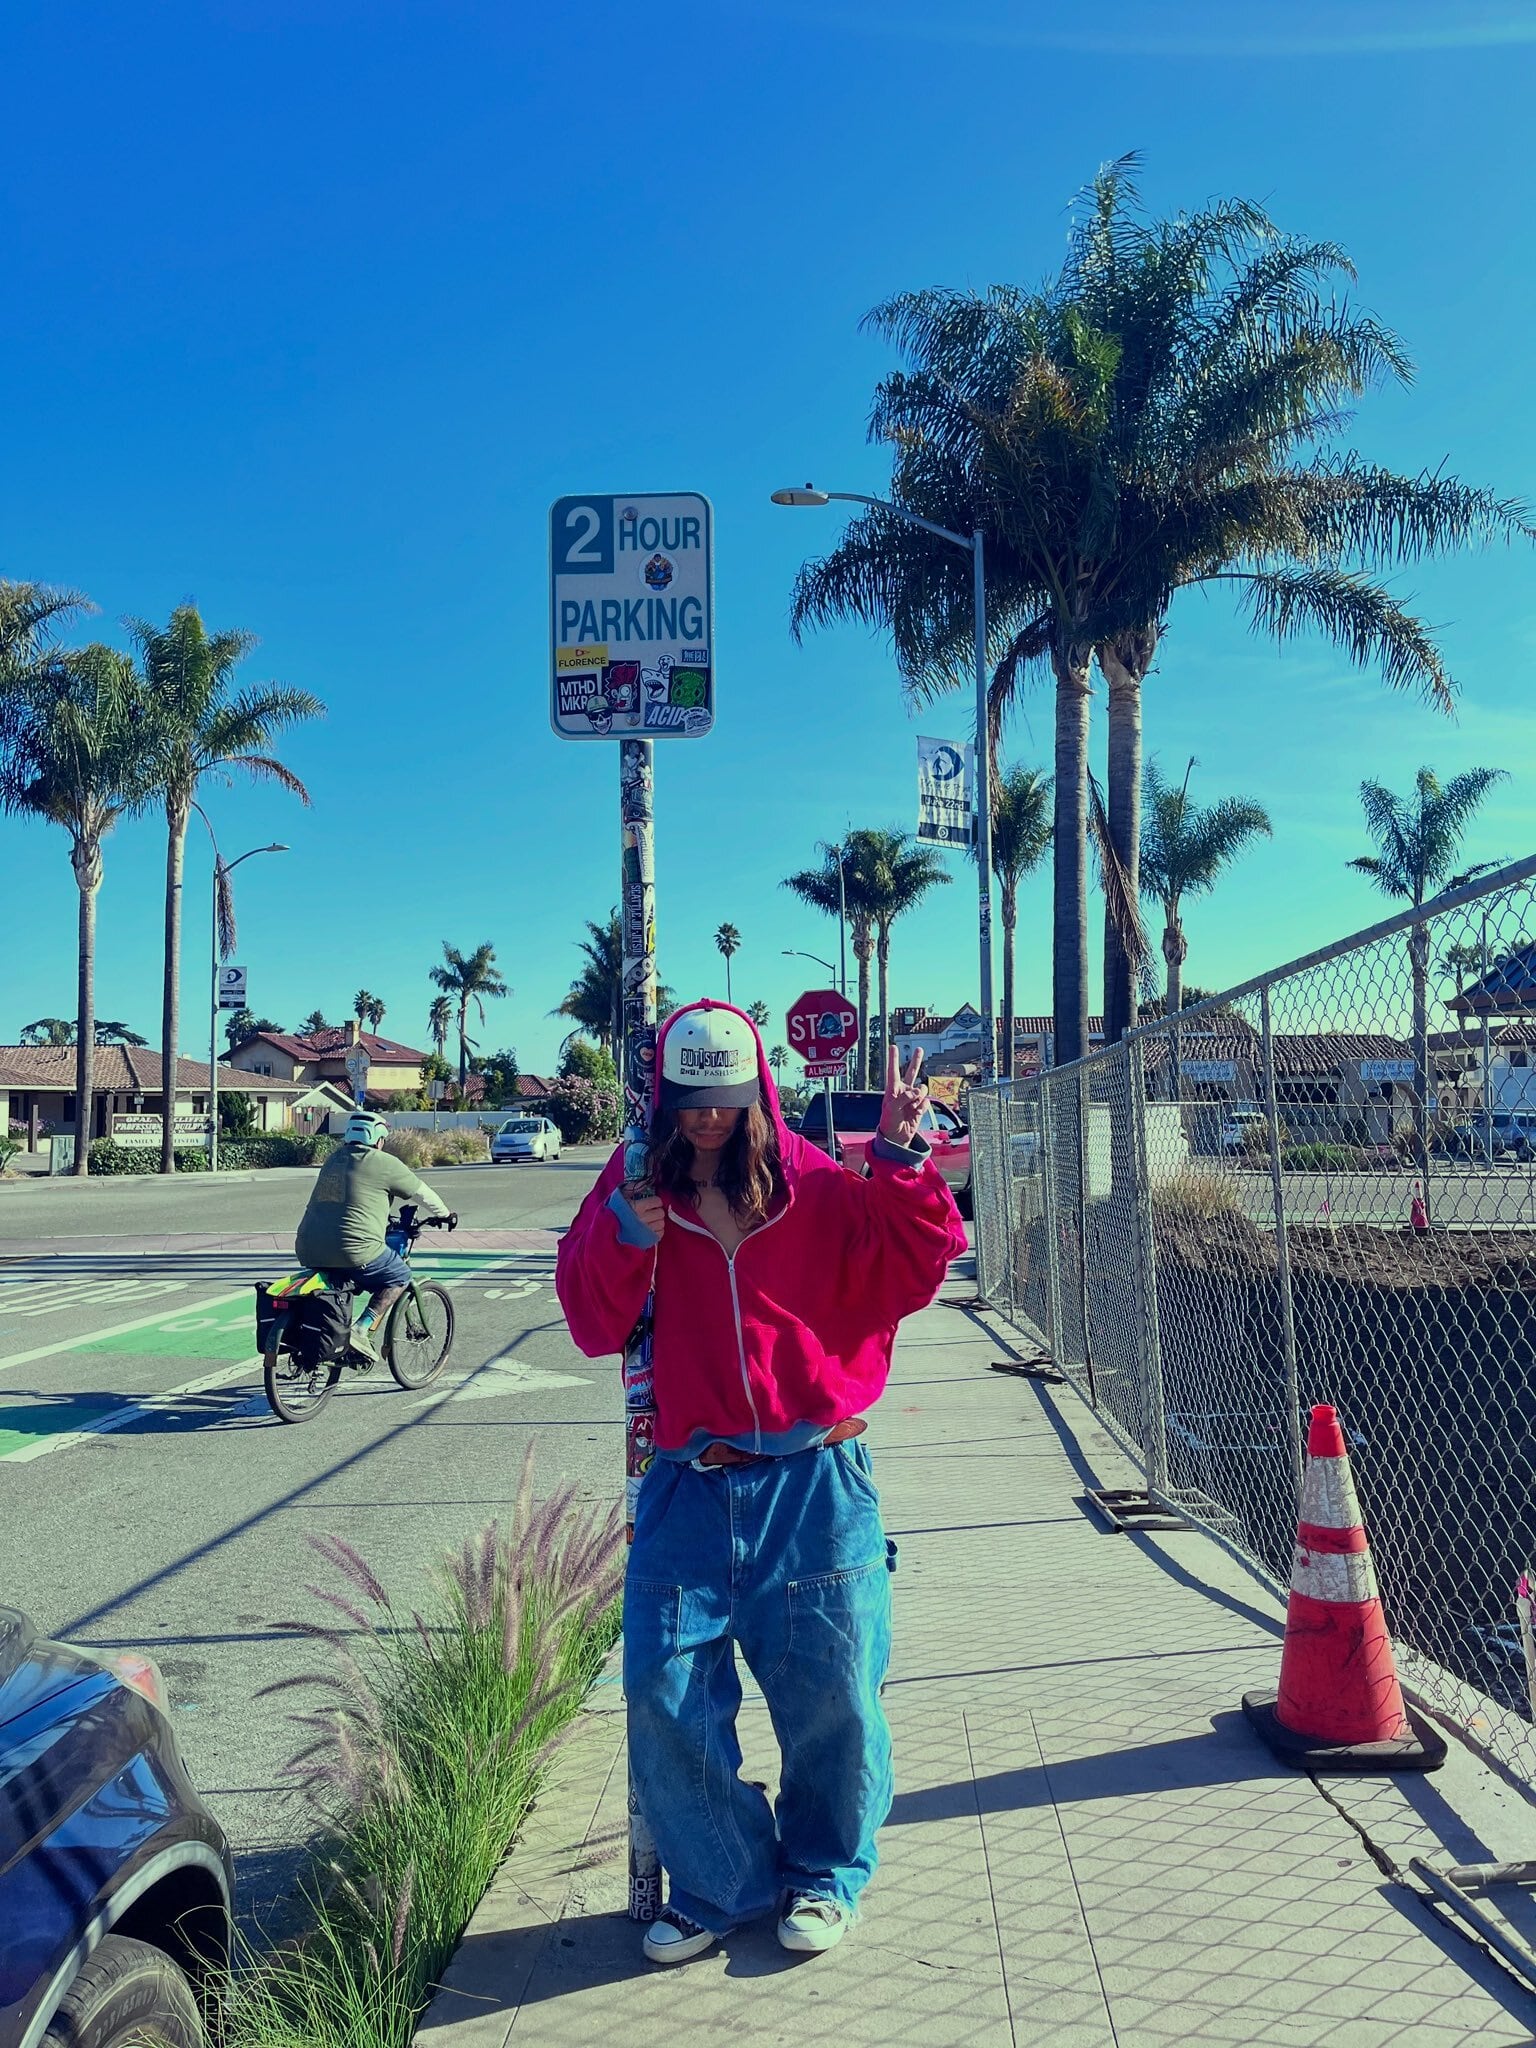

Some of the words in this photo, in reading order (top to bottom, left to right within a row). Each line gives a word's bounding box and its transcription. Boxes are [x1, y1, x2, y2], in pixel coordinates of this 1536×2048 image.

[565, 505, 602, 563] 2
[619, 517, 701, 551] HOUR
[561, 596, 703, 642] PARKING
[558, 656, 606, 668] FLORENCE
[560, 680, 596, 696] MTHD
[561, 695, 595, 711] MKR
[647, 705, 685, 725] ACID
[945, 799, 965, 810] 22nd
[631, 885, 642, 917] SEATTLE
[791, 1011, 855, 1042] STP
